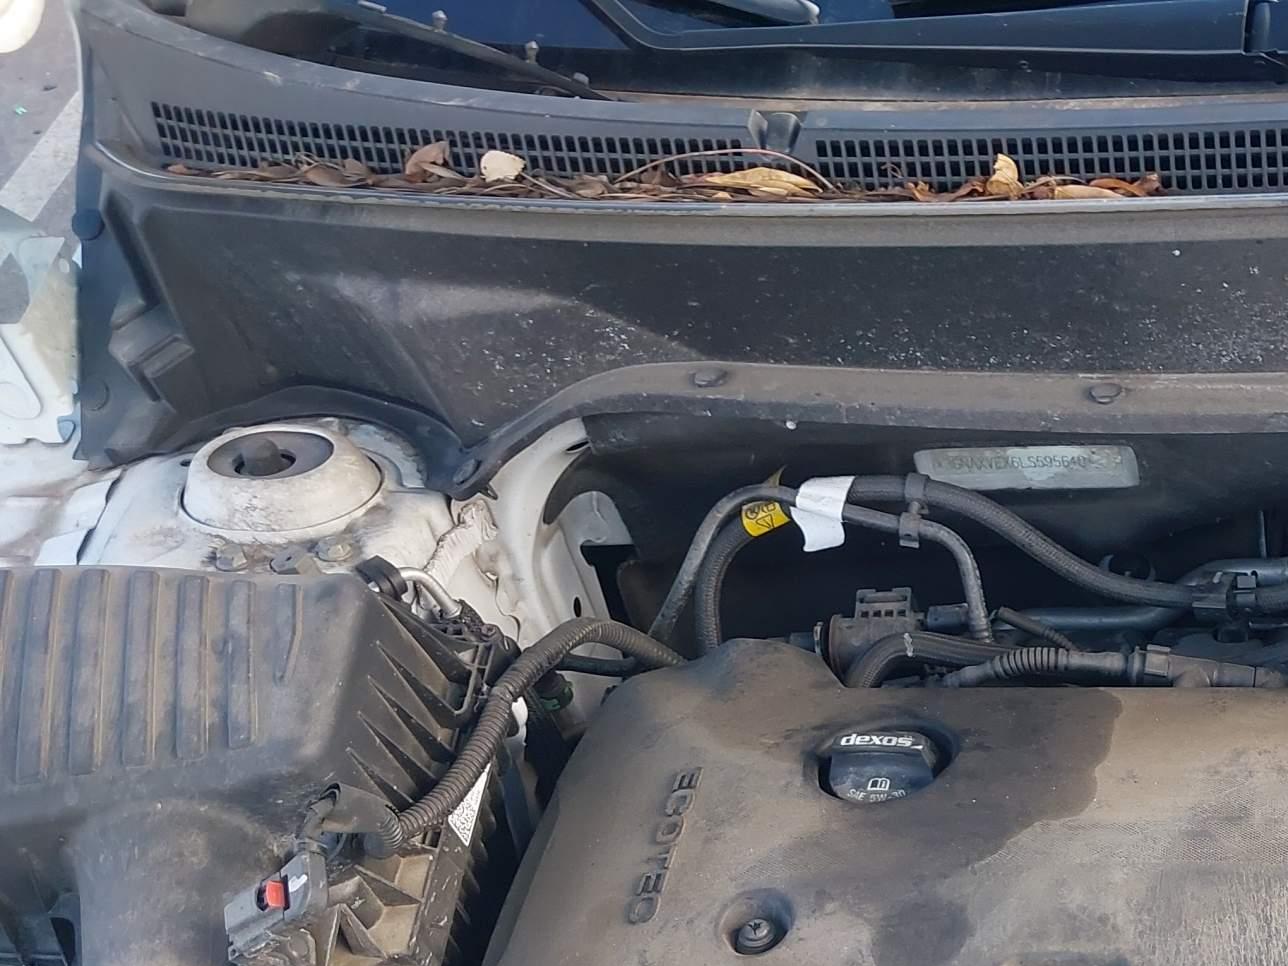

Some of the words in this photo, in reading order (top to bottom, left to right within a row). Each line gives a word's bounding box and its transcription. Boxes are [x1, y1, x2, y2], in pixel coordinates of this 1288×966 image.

[840, 733, 914, 748] dexos
[847, 788, 867, 801] SAE
[869, 788, 907, 803] 5W-30
[629, 767, 705, 924] ECOTEC
